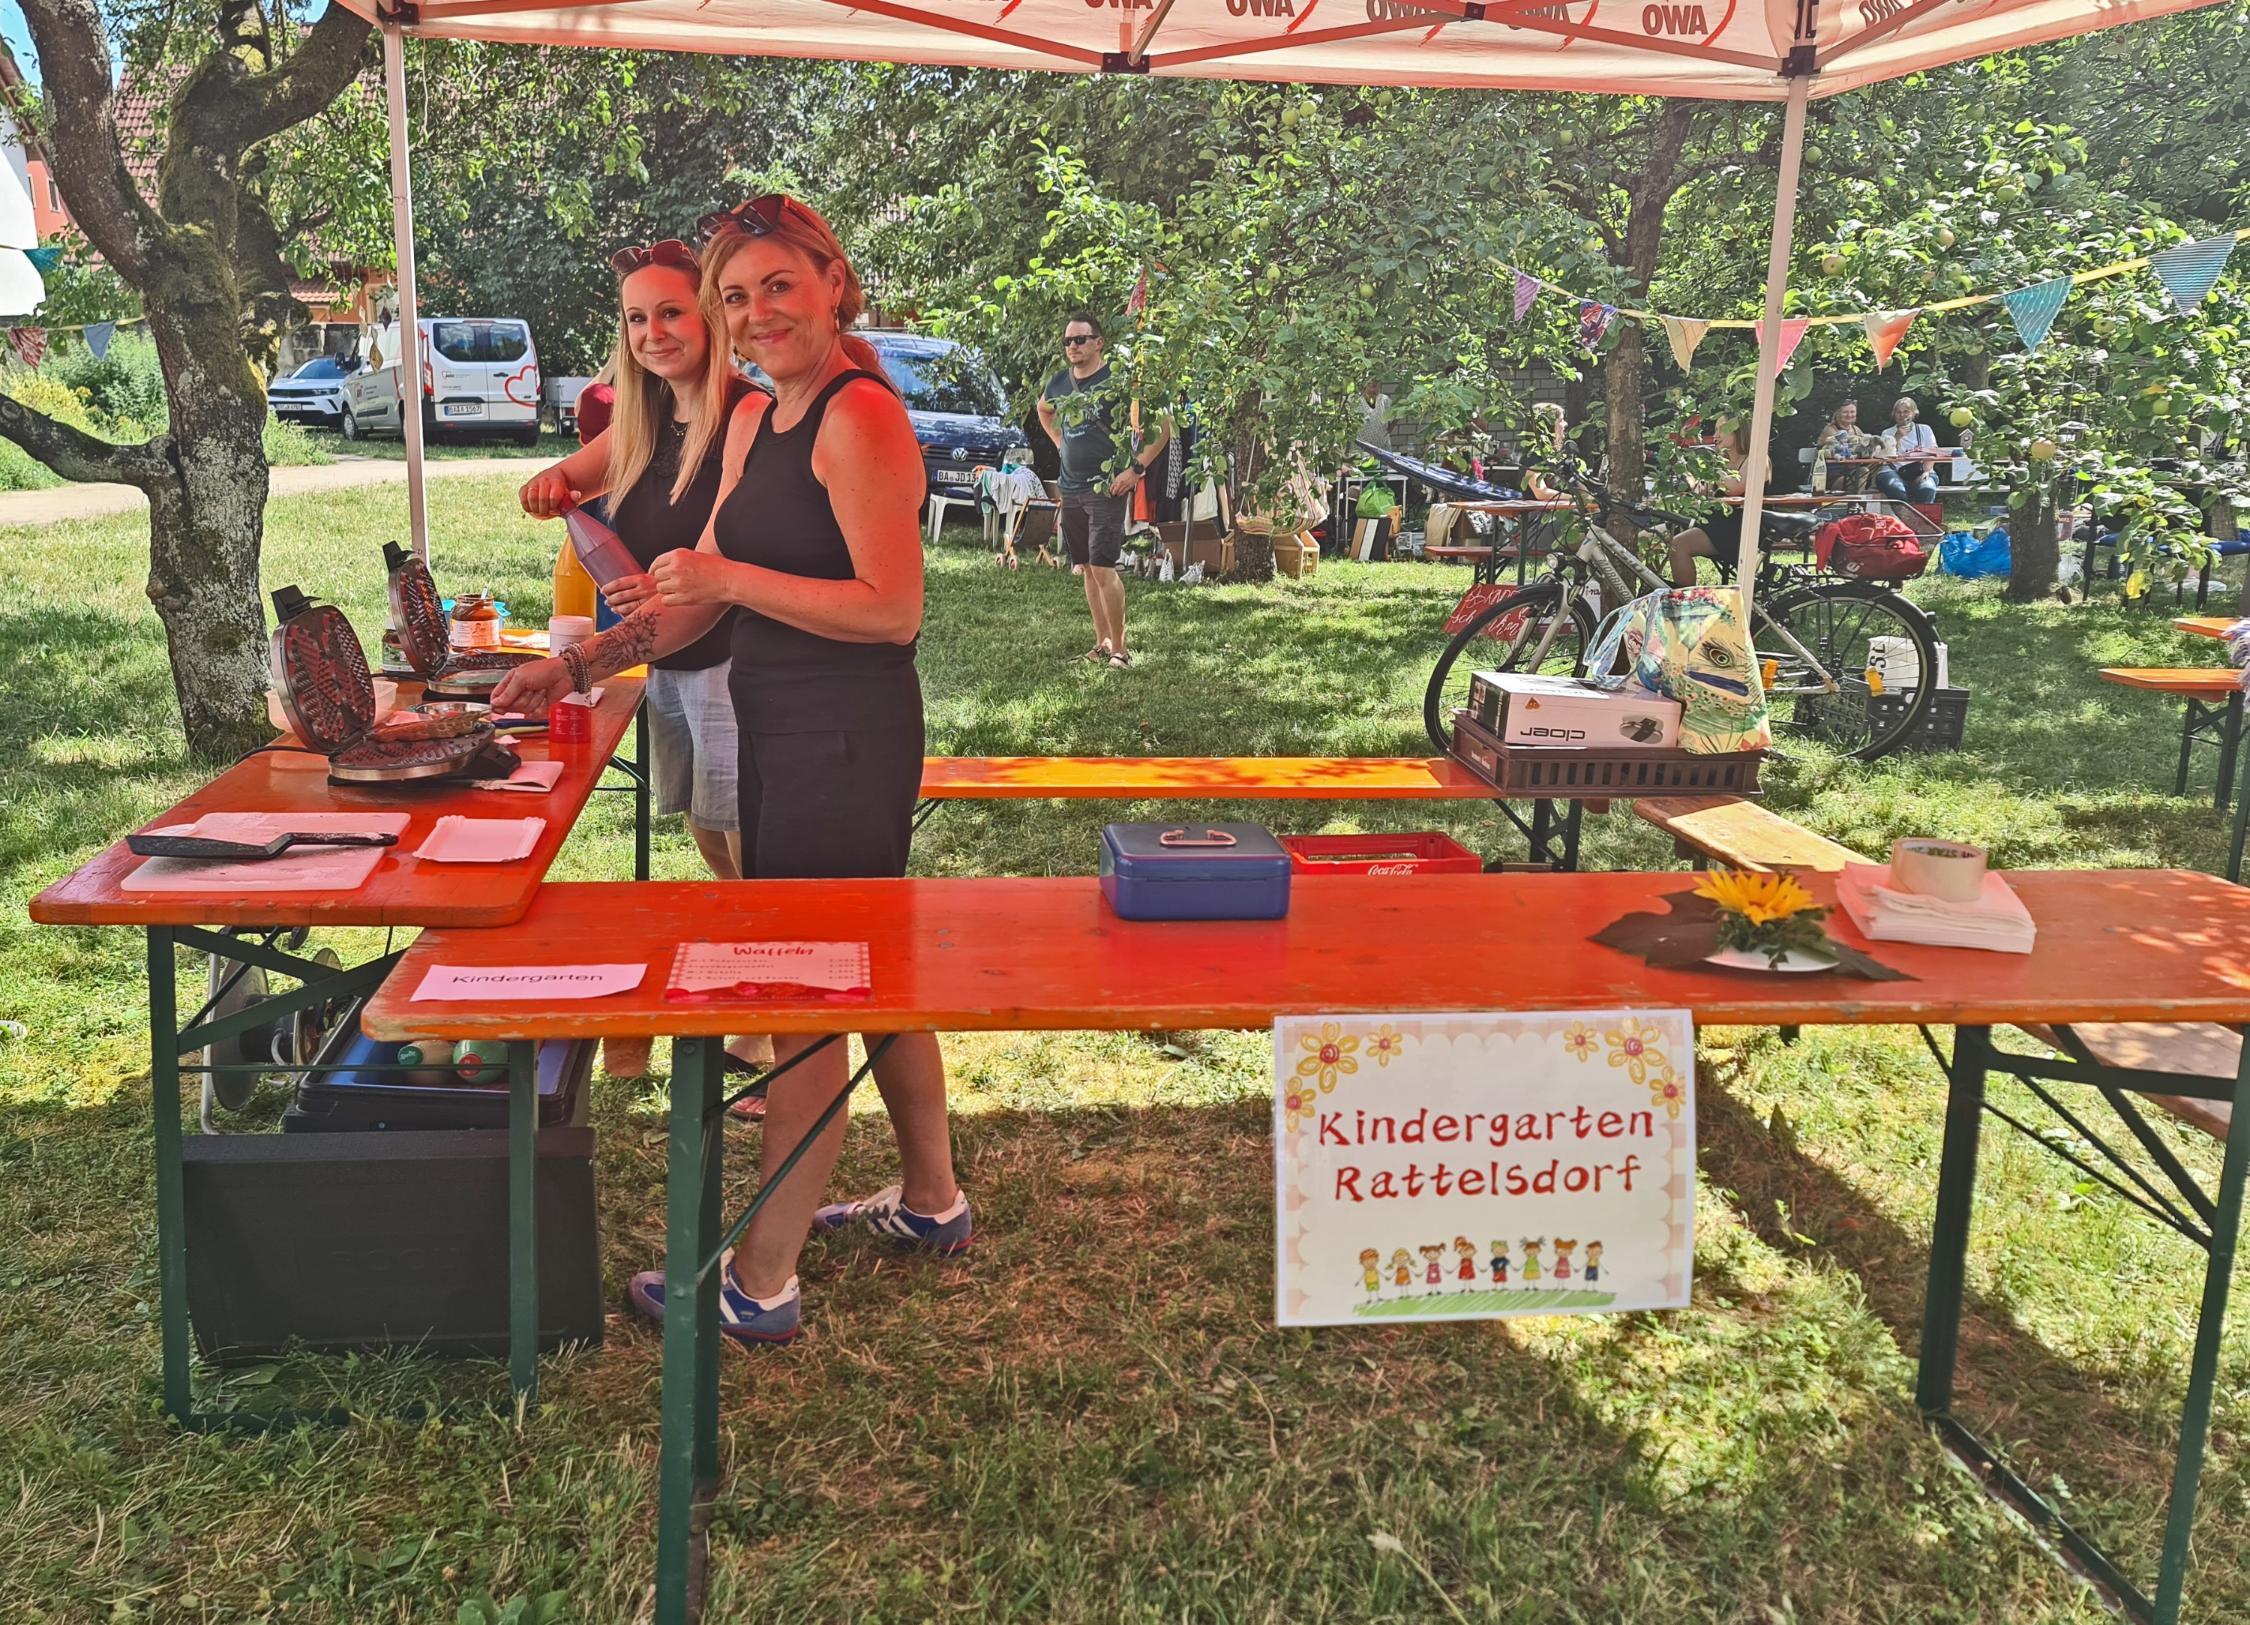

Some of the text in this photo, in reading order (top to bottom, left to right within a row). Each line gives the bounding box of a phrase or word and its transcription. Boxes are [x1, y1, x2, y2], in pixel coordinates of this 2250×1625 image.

[1642, 4, 1708, 35] OWA
[1519, 727, 1586, 742] cloer
[451, 973, 604, 984] Kindergarten
[1318, 1105, 1654, 1148] Kindergarten
[1335, 1154, 1642, 1203] Rattelsdorf
